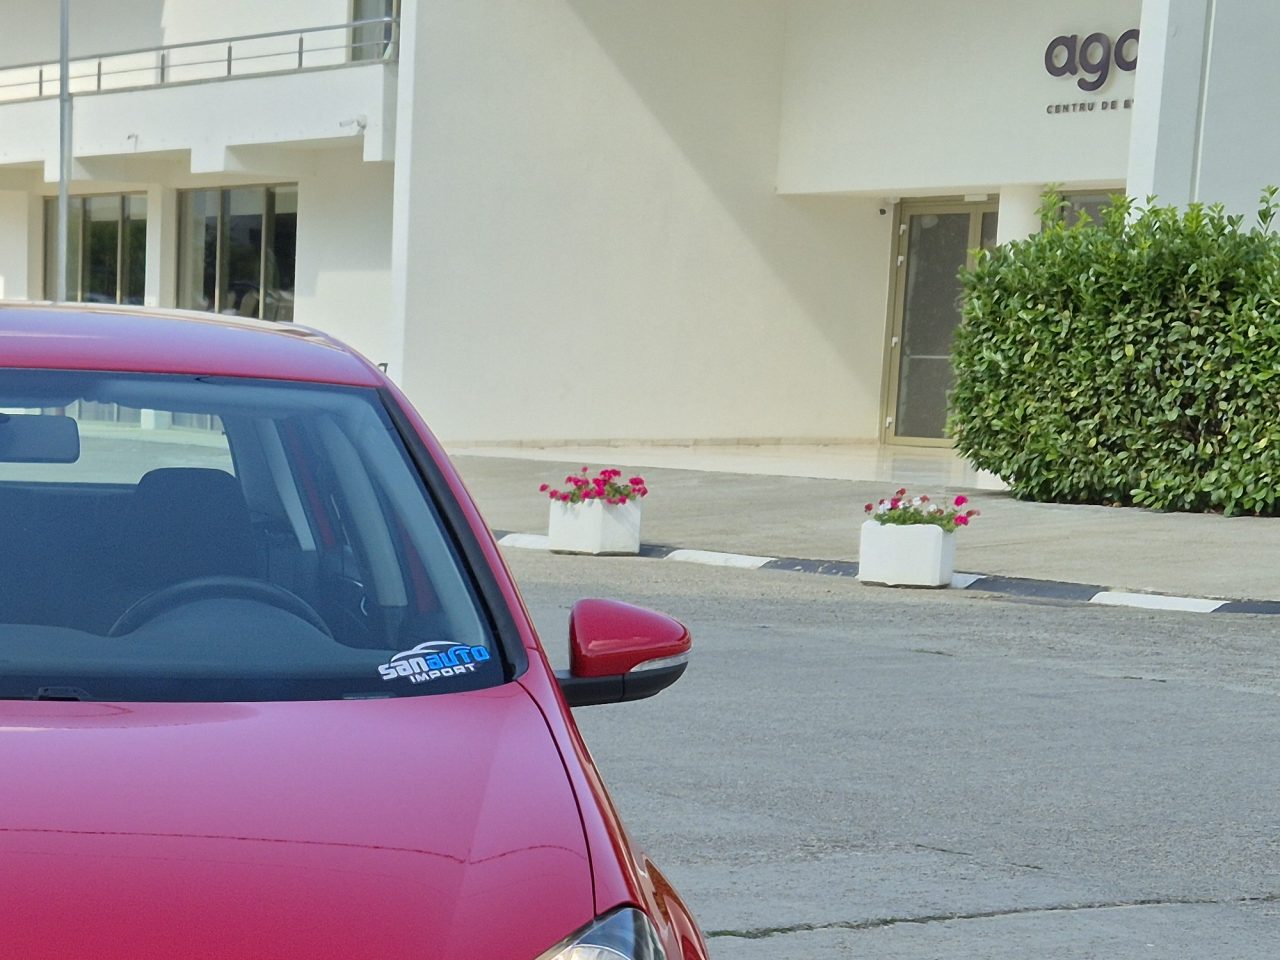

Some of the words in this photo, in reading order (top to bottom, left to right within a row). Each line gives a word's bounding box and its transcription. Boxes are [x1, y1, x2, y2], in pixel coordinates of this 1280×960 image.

[1046, 102, 1096, 114] CENTRU
[1101, 100, 1118, 110] DE
[1123, 99, 1134, 109] E
[410, 663, 475, 683] IMPORT
